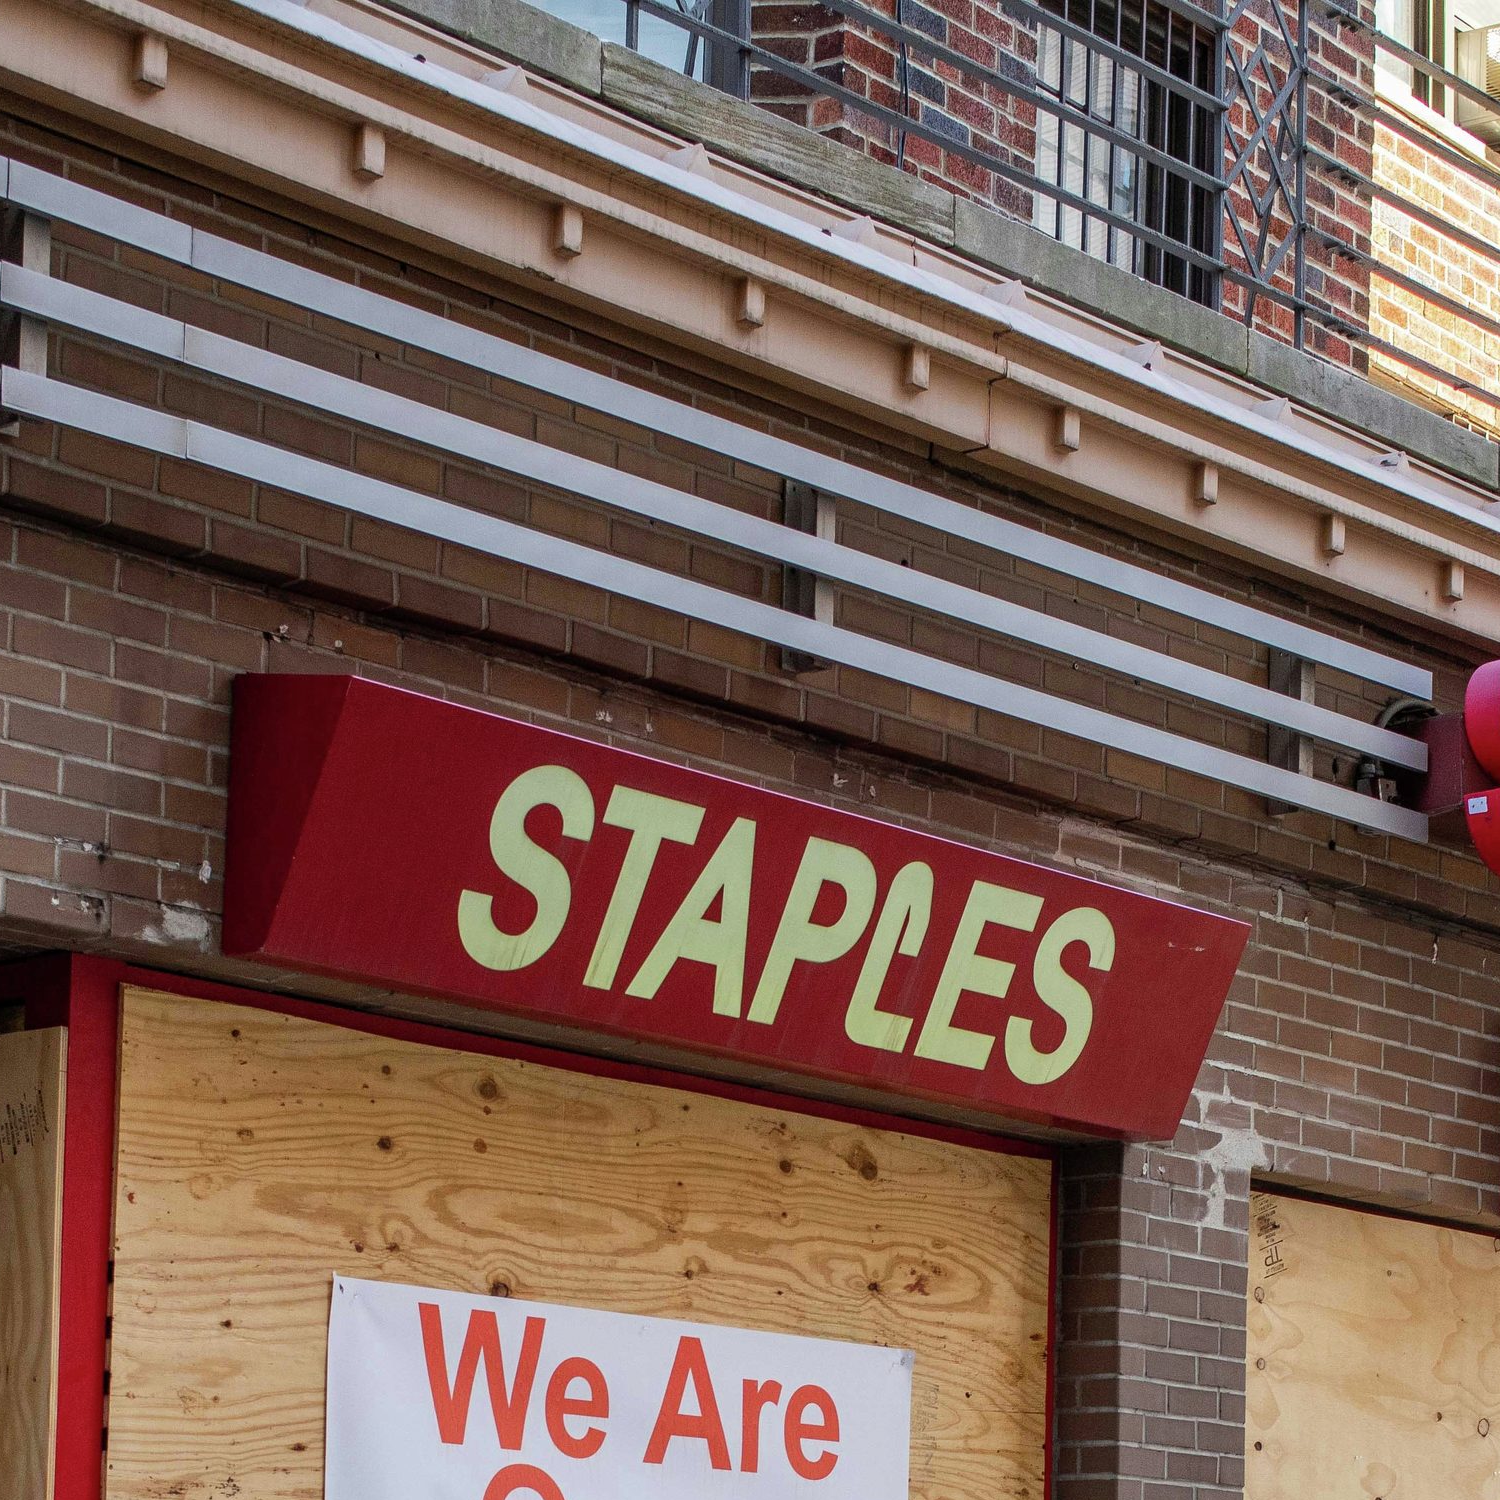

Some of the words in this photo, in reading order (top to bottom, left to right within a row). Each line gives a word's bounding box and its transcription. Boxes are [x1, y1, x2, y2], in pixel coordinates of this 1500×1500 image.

[457, 763, 1116, 1086] STAPLES
[418, 1301, 609, 1460] We
[642, 1335, 840, 1481] Are
